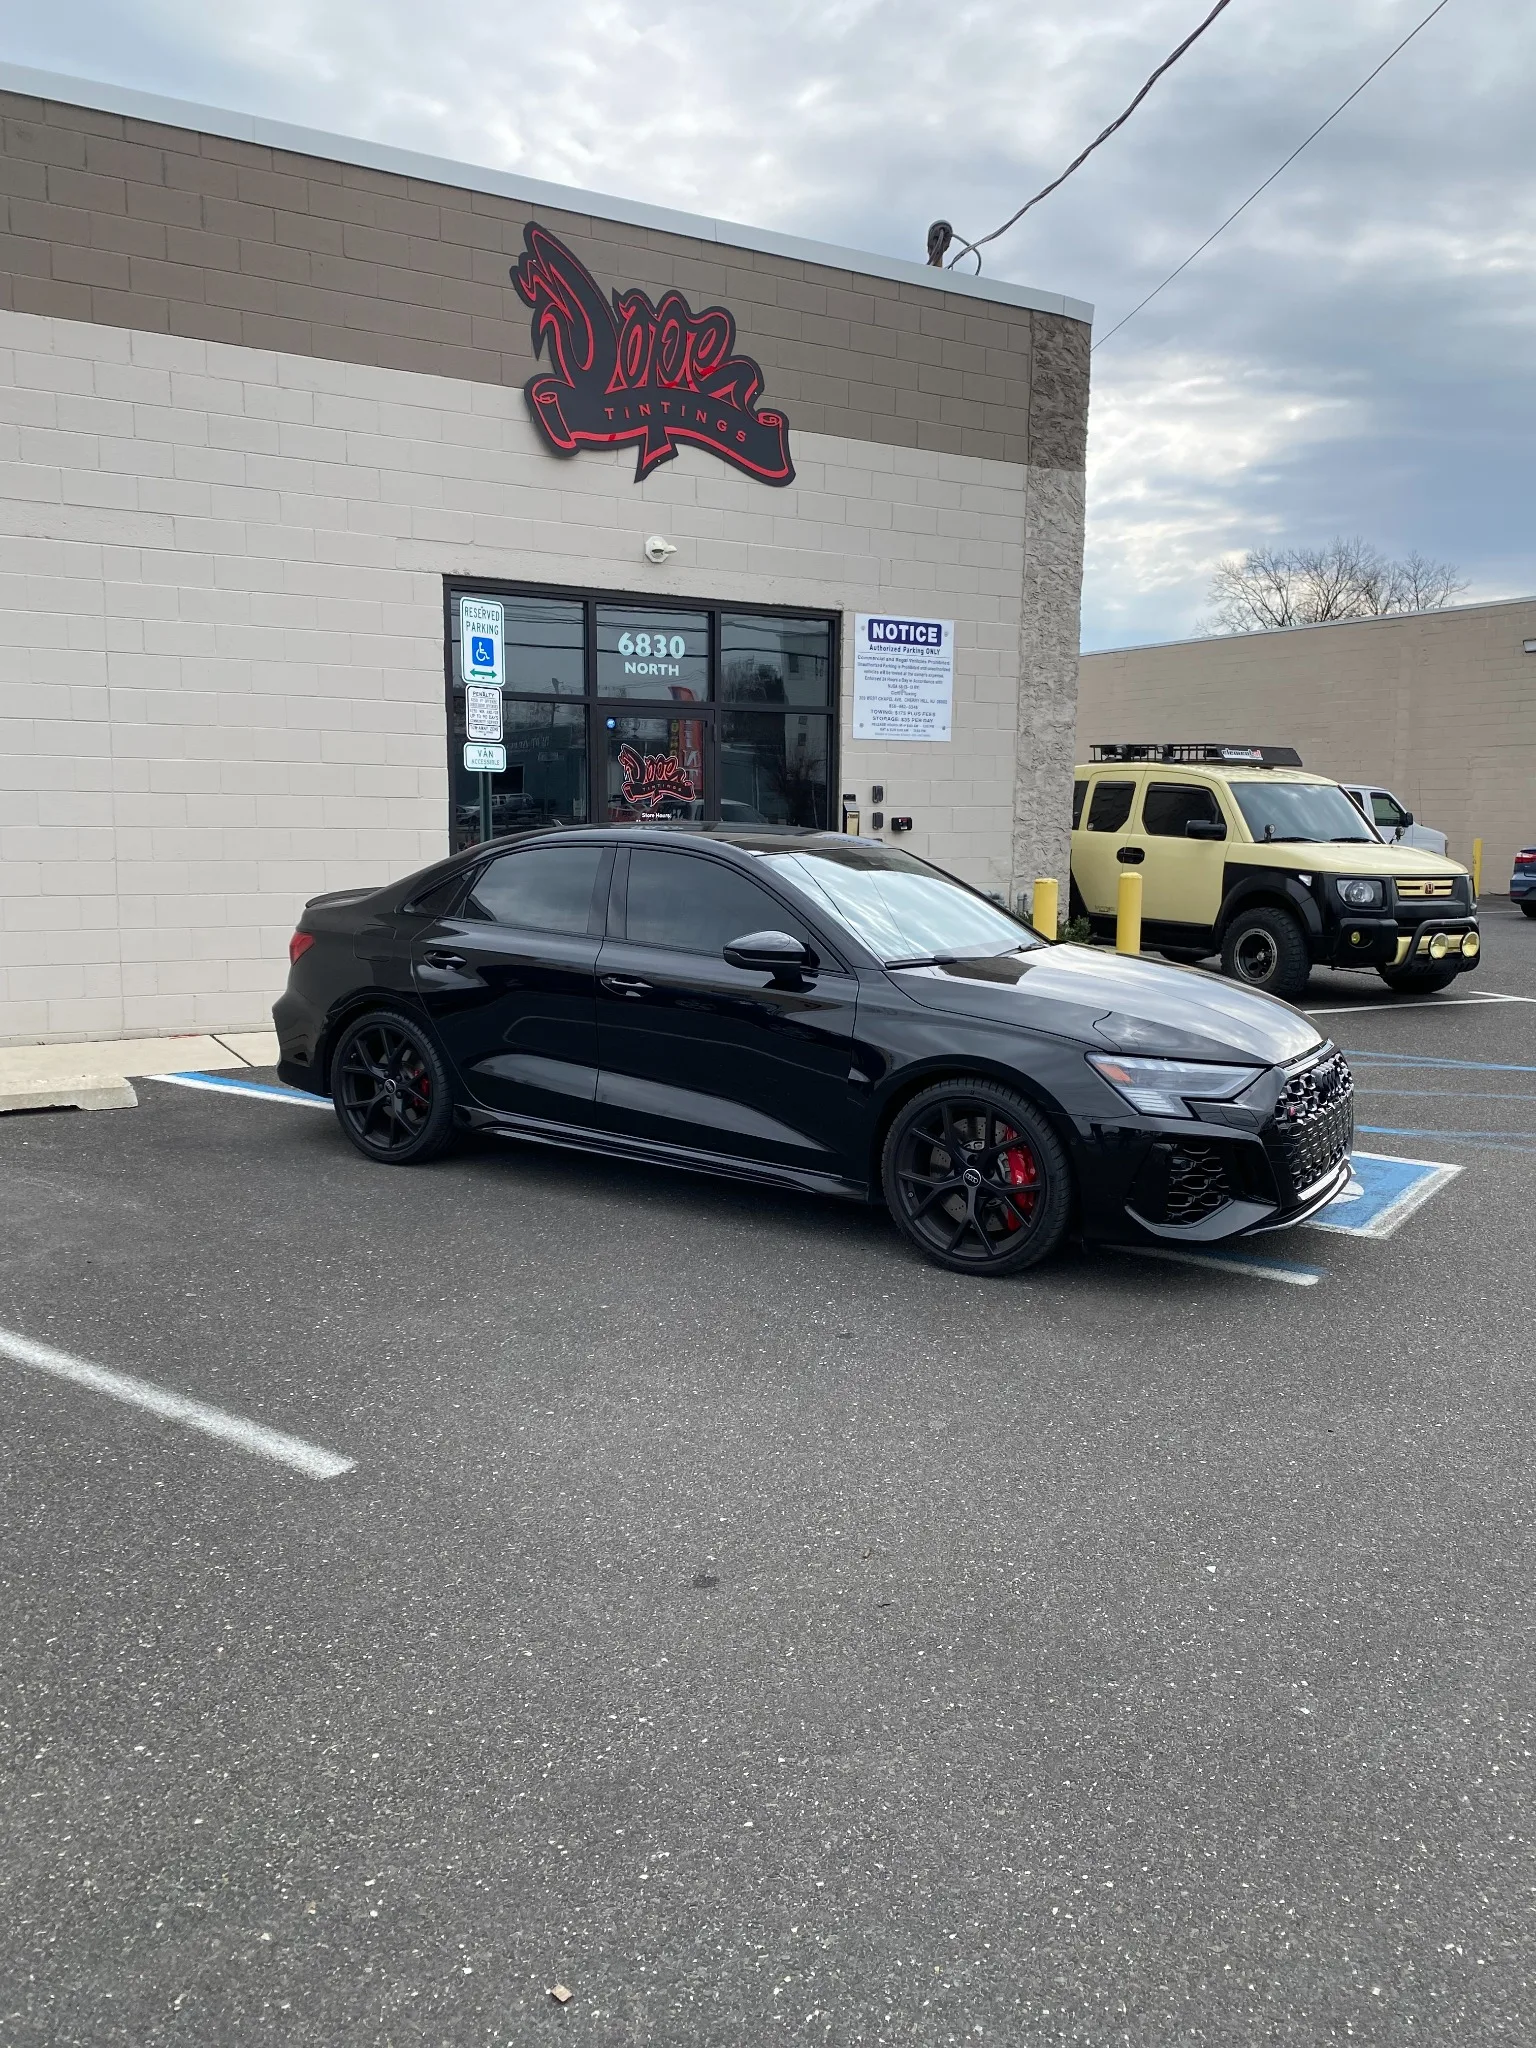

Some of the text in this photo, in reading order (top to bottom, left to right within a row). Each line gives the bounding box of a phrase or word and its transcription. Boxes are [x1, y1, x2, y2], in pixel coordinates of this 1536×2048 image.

[604, 400, 747, 443] TINTINGS
[464, 605, 500, 622] RESERVED
[465, 620, 499, 636] PARKING
[872, 622, 938, 643] NOTICE
[618, 632, 686, 659] 6830
[869, 644, 901, 653] Authorized
[902, 646, 924, 656] Parking
[624, 661, 680, 677] NORTH
[477, 748, 494, 759] VAN
[471, 758, 500, 766] ACCESSIBLE
[642, 783, 682, 792] TINTINGS
